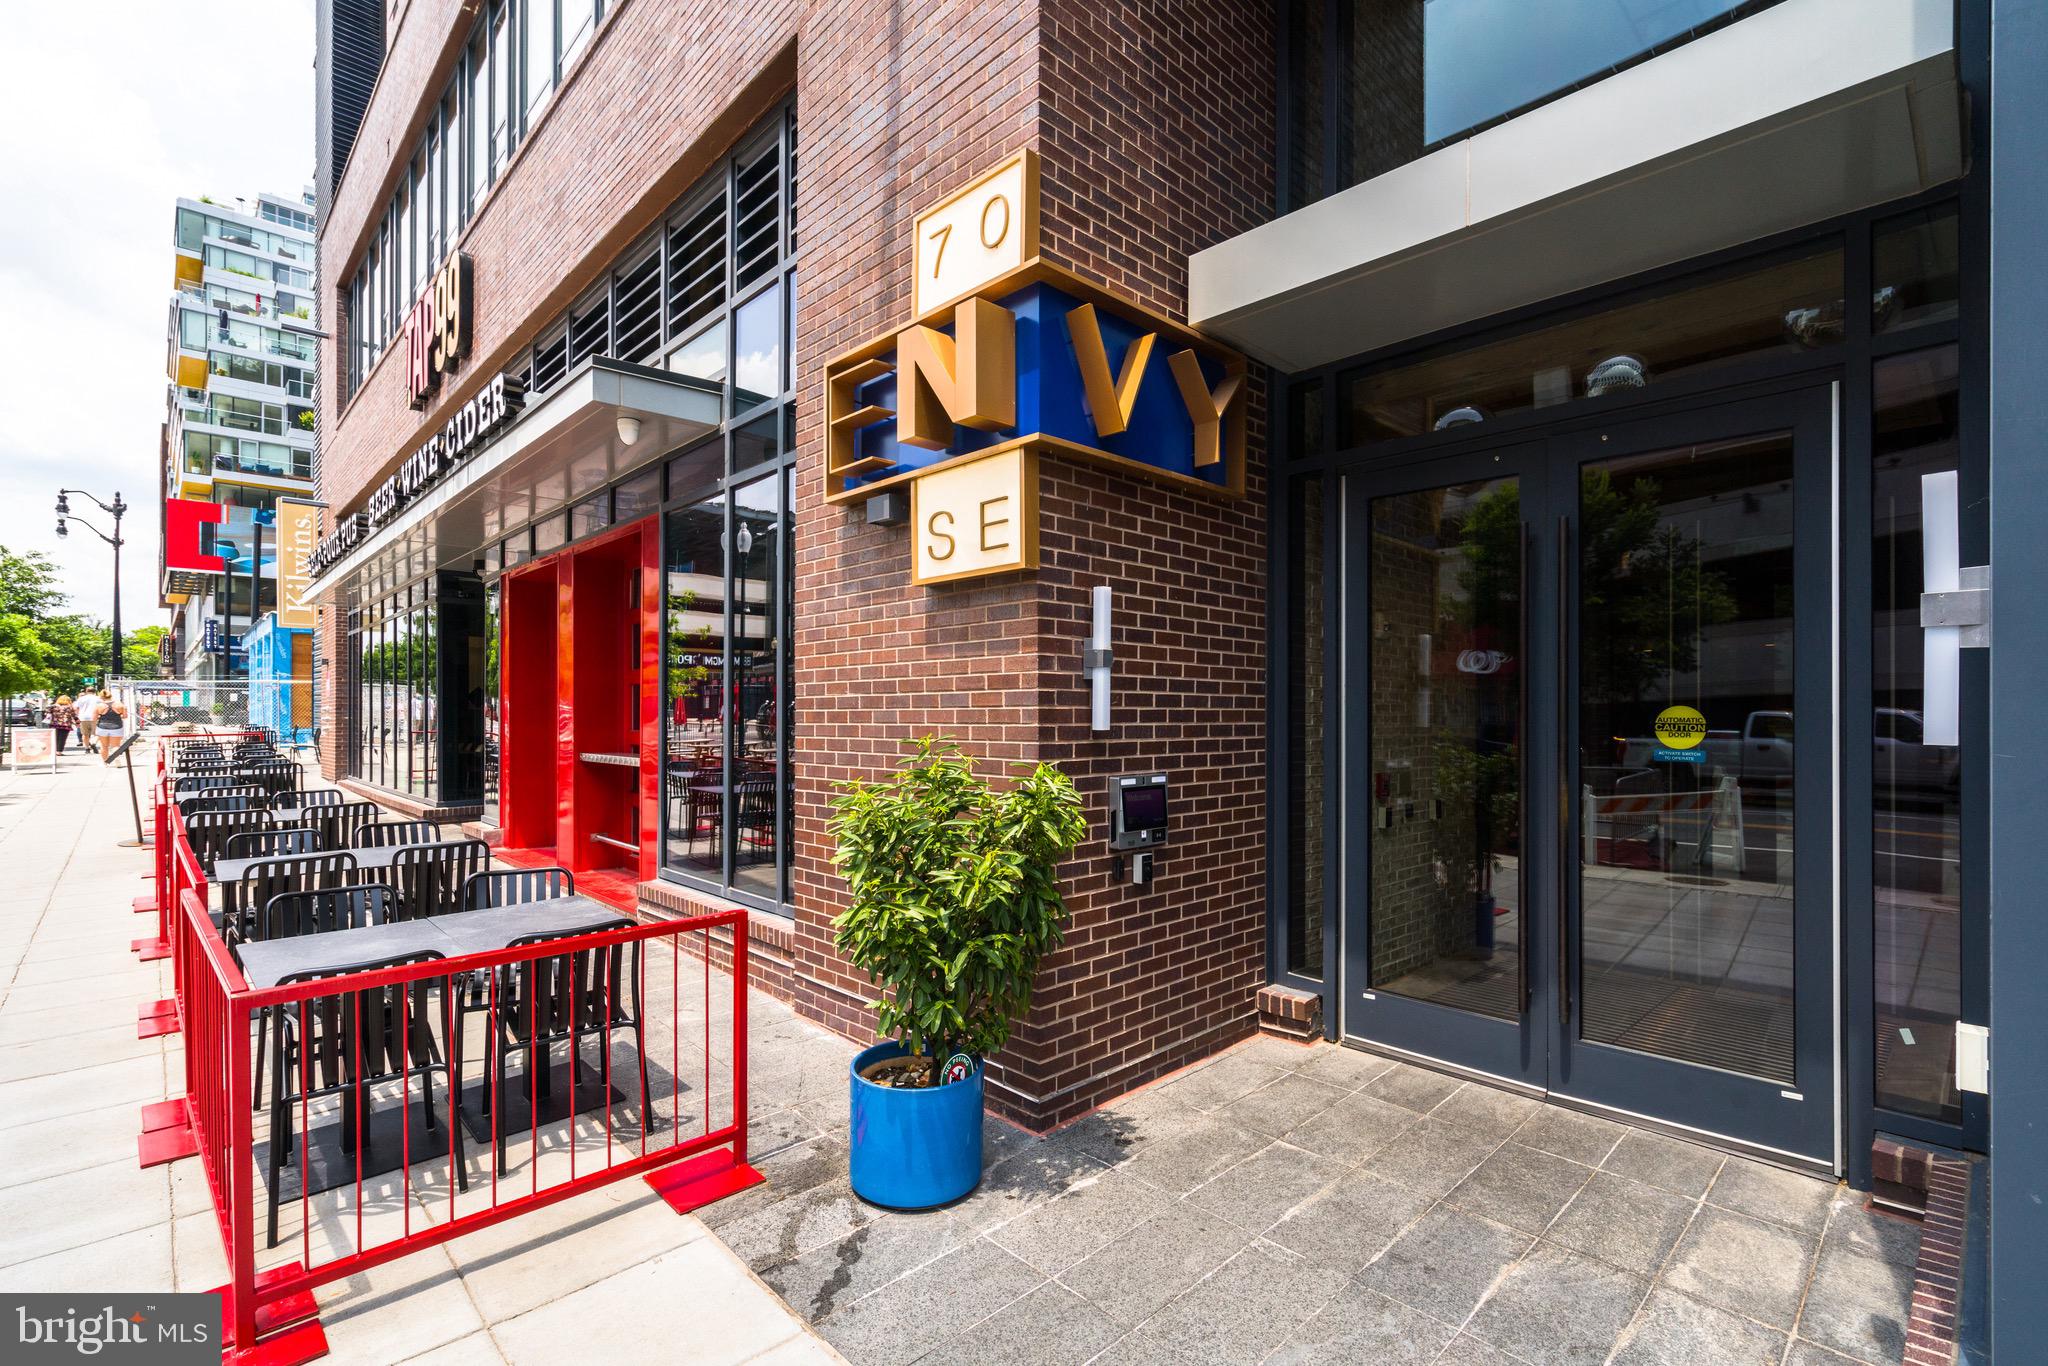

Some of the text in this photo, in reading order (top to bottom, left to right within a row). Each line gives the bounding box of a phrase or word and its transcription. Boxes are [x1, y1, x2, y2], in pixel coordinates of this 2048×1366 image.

[928, 193, 1010, 279] 70
[829, 296, 1243, 468] ENVY
[368, 372, 506, 527] BEER WINE CIDER
[341, 512, 357, 550] PUB
[927, 495, 1009, 560] SE
[1655, 724, 1706, 732] CAUTION
[945, 1056, 970, 1075] NO PEEING
